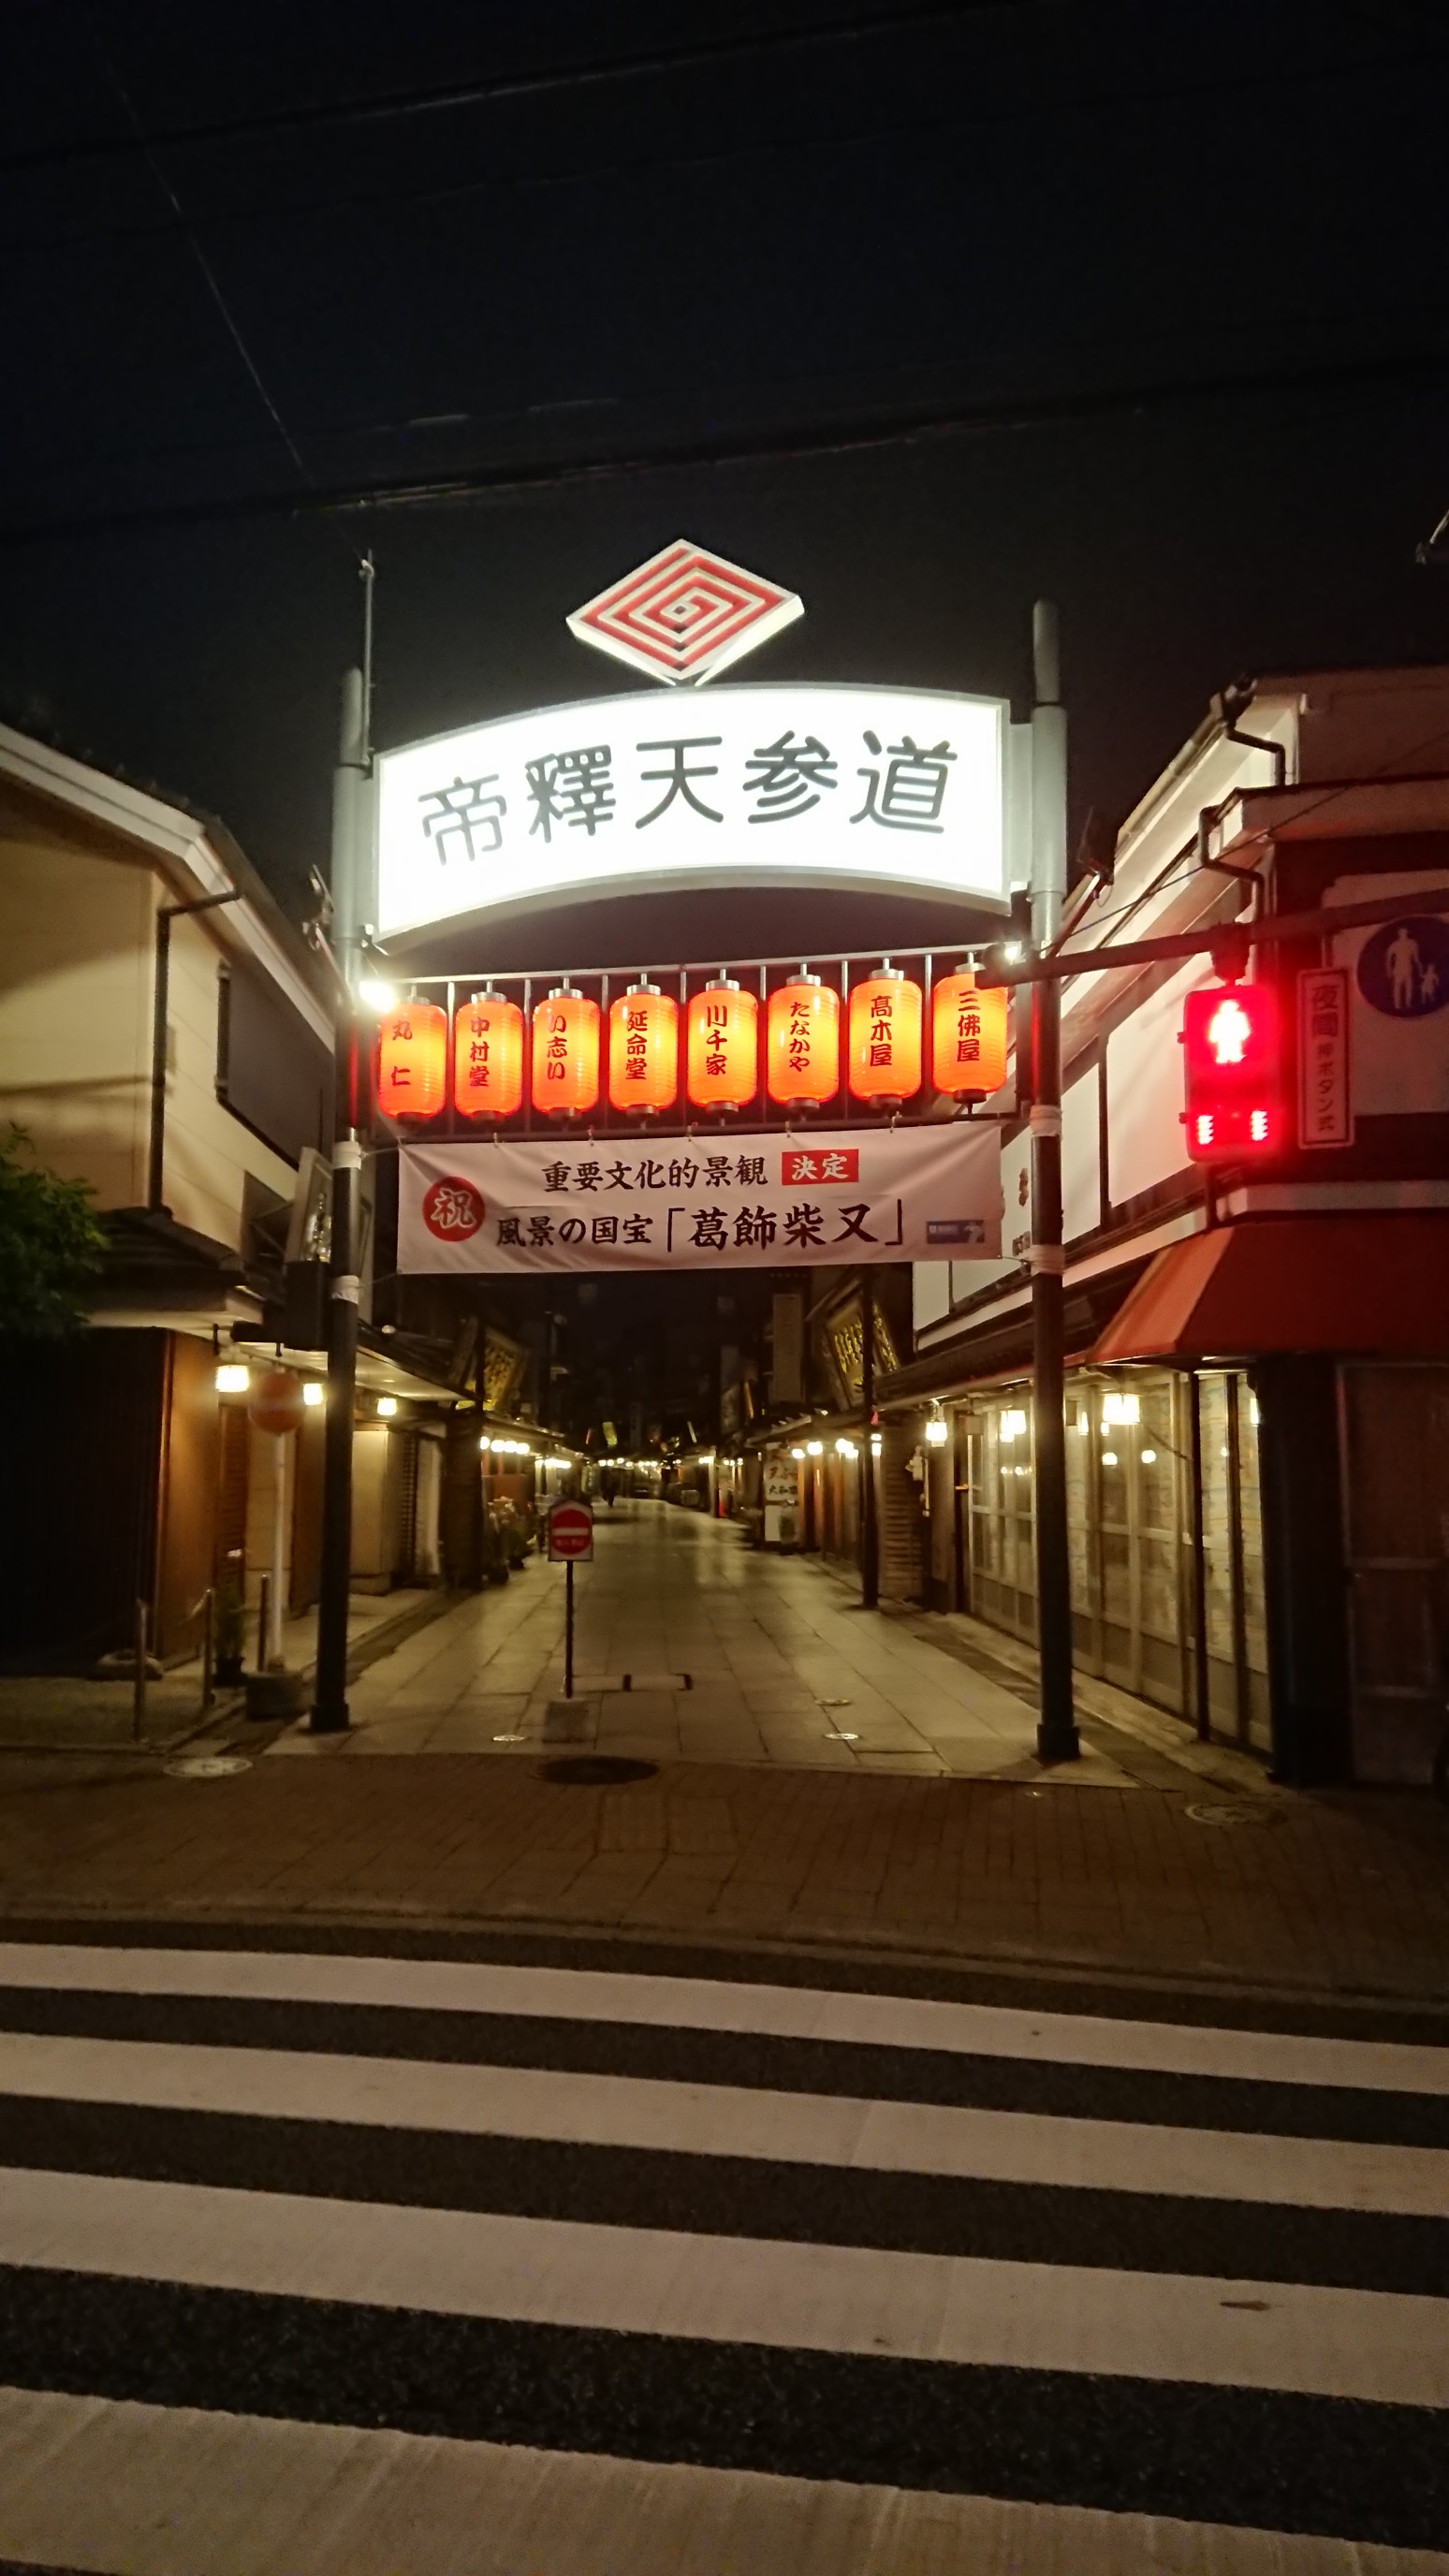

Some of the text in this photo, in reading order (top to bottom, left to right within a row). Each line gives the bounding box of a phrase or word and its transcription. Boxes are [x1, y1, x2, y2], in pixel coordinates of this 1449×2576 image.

[417, 730, 958, 866] 帝釋天参道
[391, 1019, 413, 1087] 丸仁
[470, 1016, 490, 1087] 中村堂
[625, 1010, 648, 1080] 延命堂
[706, 1004, 727, 1076] 川千家
[789, 1001, 811, 1073] たなかや
[541, 1152, 850, 1193] 重要文化的景観 決定
[431, 1186, 477, 1230] 祝
